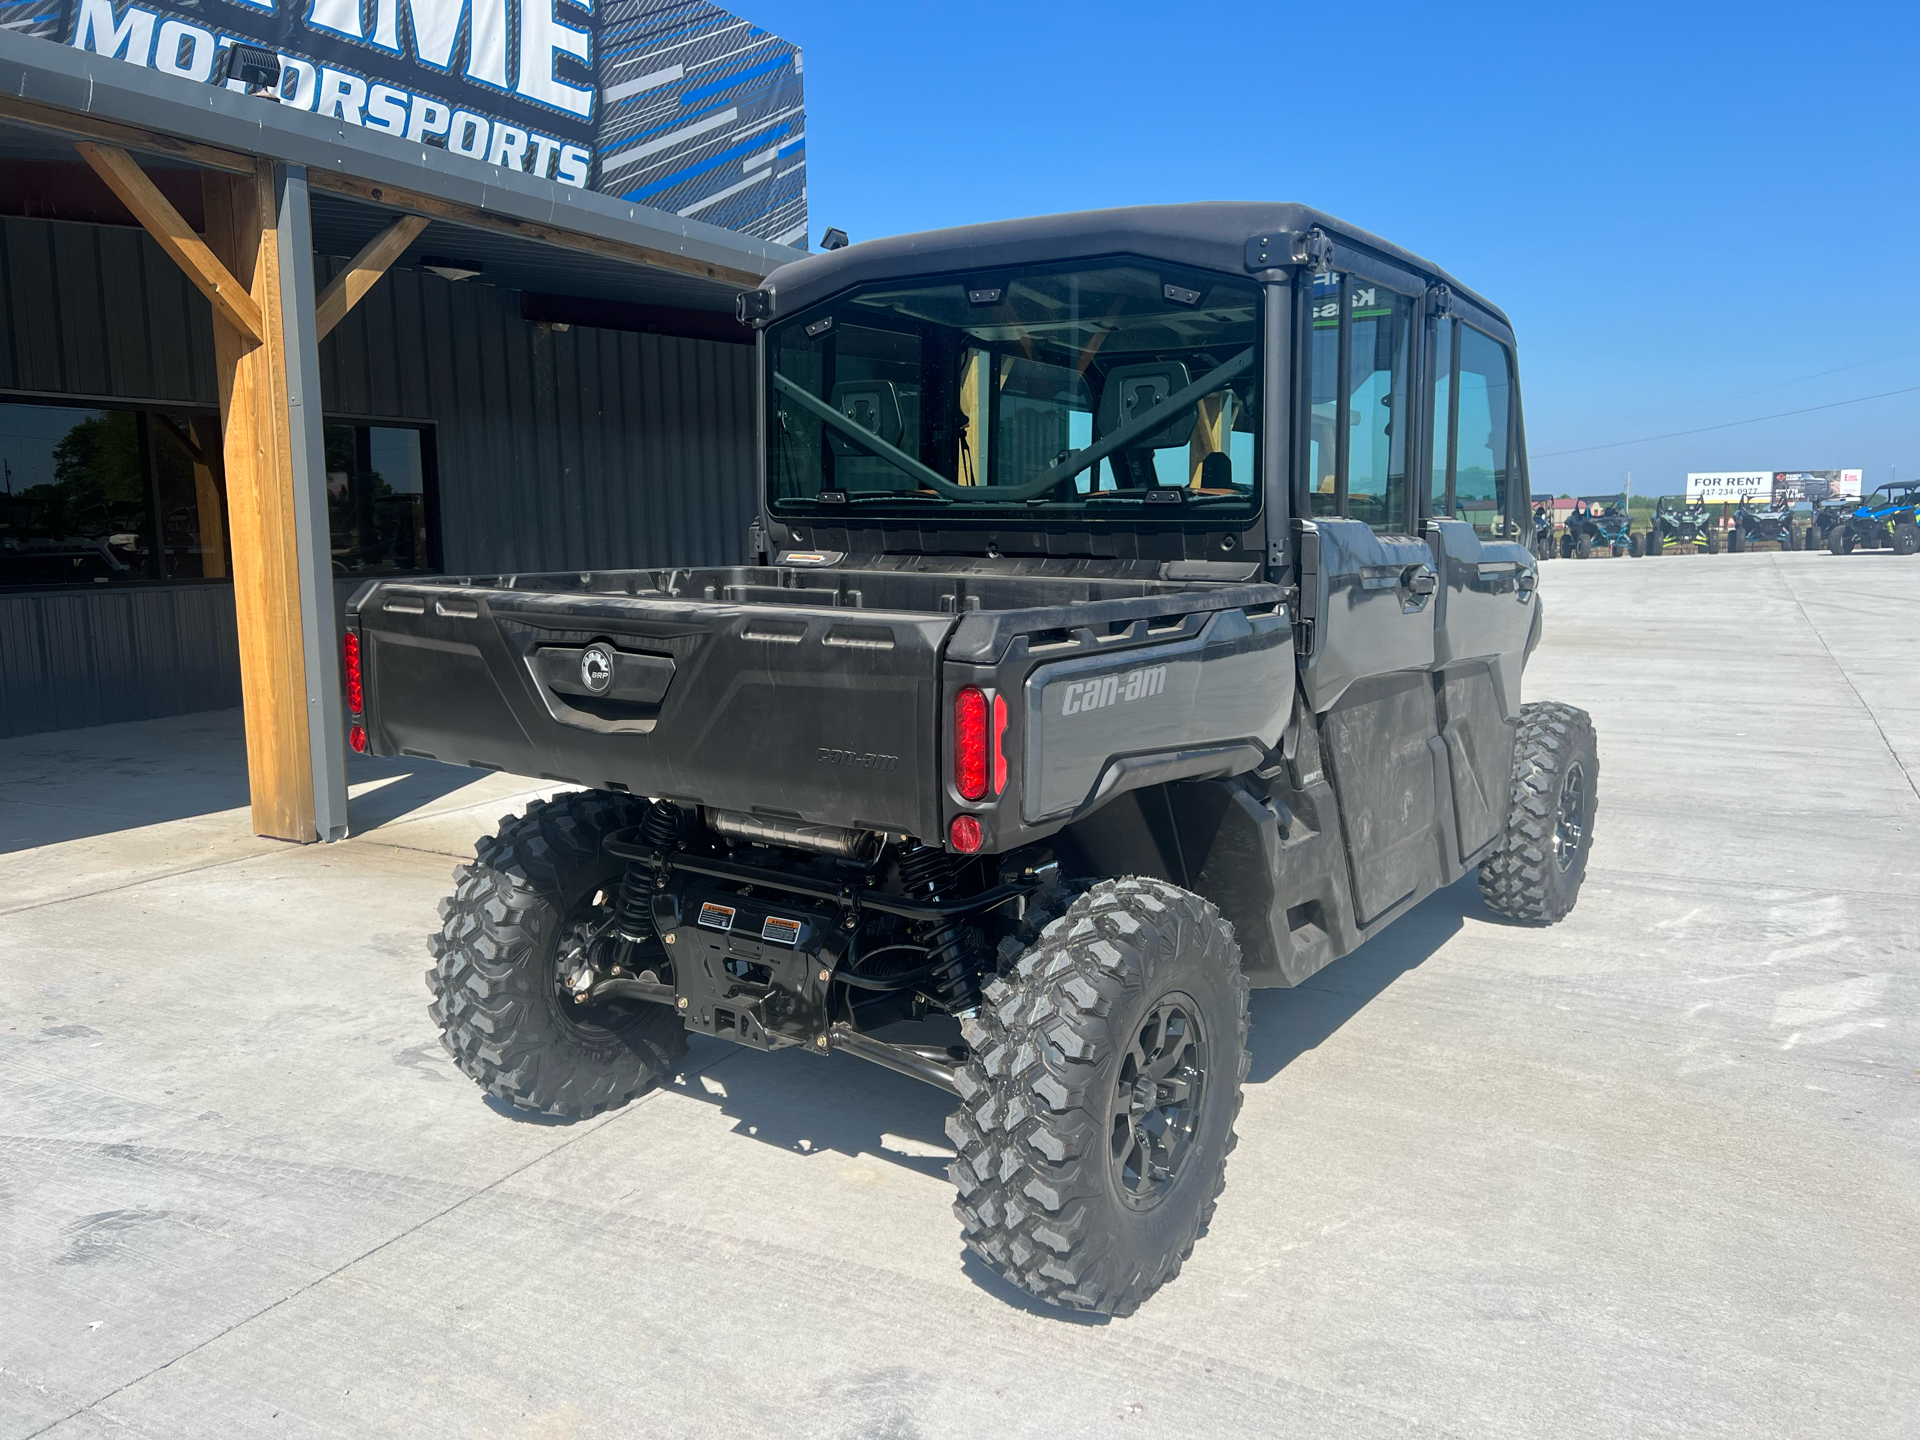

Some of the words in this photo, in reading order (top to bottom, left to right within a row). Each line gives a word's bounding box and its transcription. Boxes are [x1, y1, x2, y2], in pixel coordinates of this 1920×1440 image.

[1694, 478, 1722, 486] FOR
[1726, 477, 1764, 486] RENT
[1701, 488, 1758, 496] 417-234-0977
[591, 671, 609, 679] BRP
